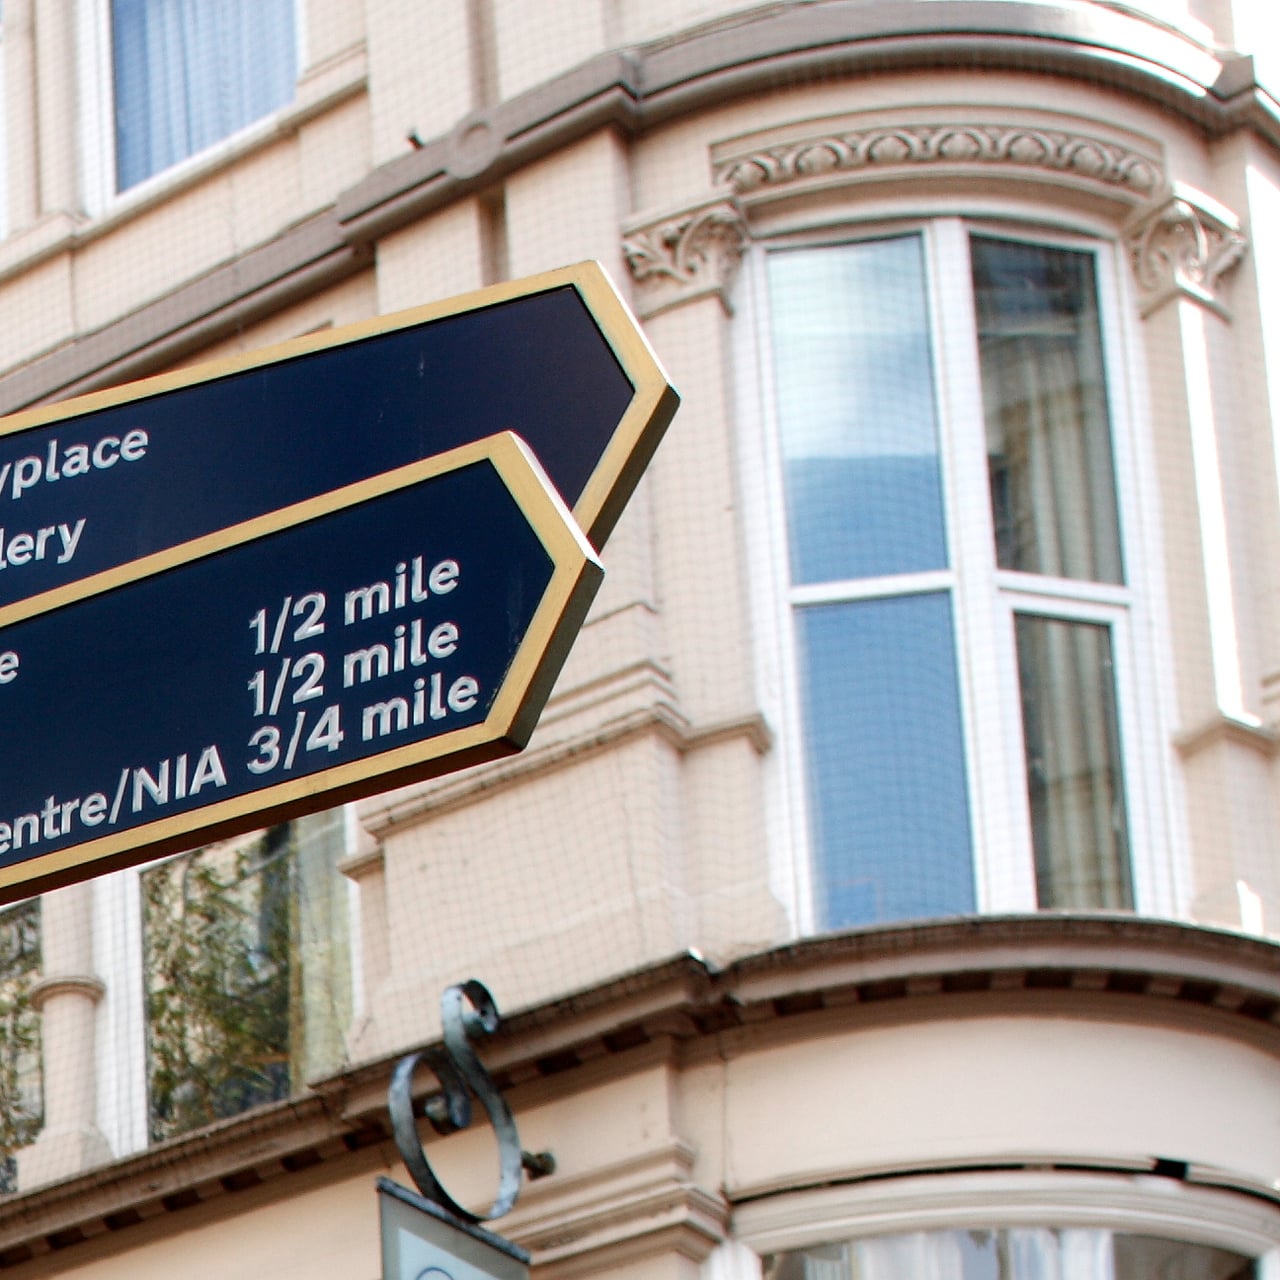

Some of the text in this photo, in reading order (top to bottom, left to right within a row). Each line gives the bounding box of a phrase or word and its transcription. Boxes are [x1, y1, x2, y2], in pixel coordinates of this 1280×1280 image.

[248, 556, 460, 655] 1/2 mile
[247, 619, 458, 716] 1/2 mile
[247, 704, 344, 774] 3/4
[362, 673, 479, 741] mile
